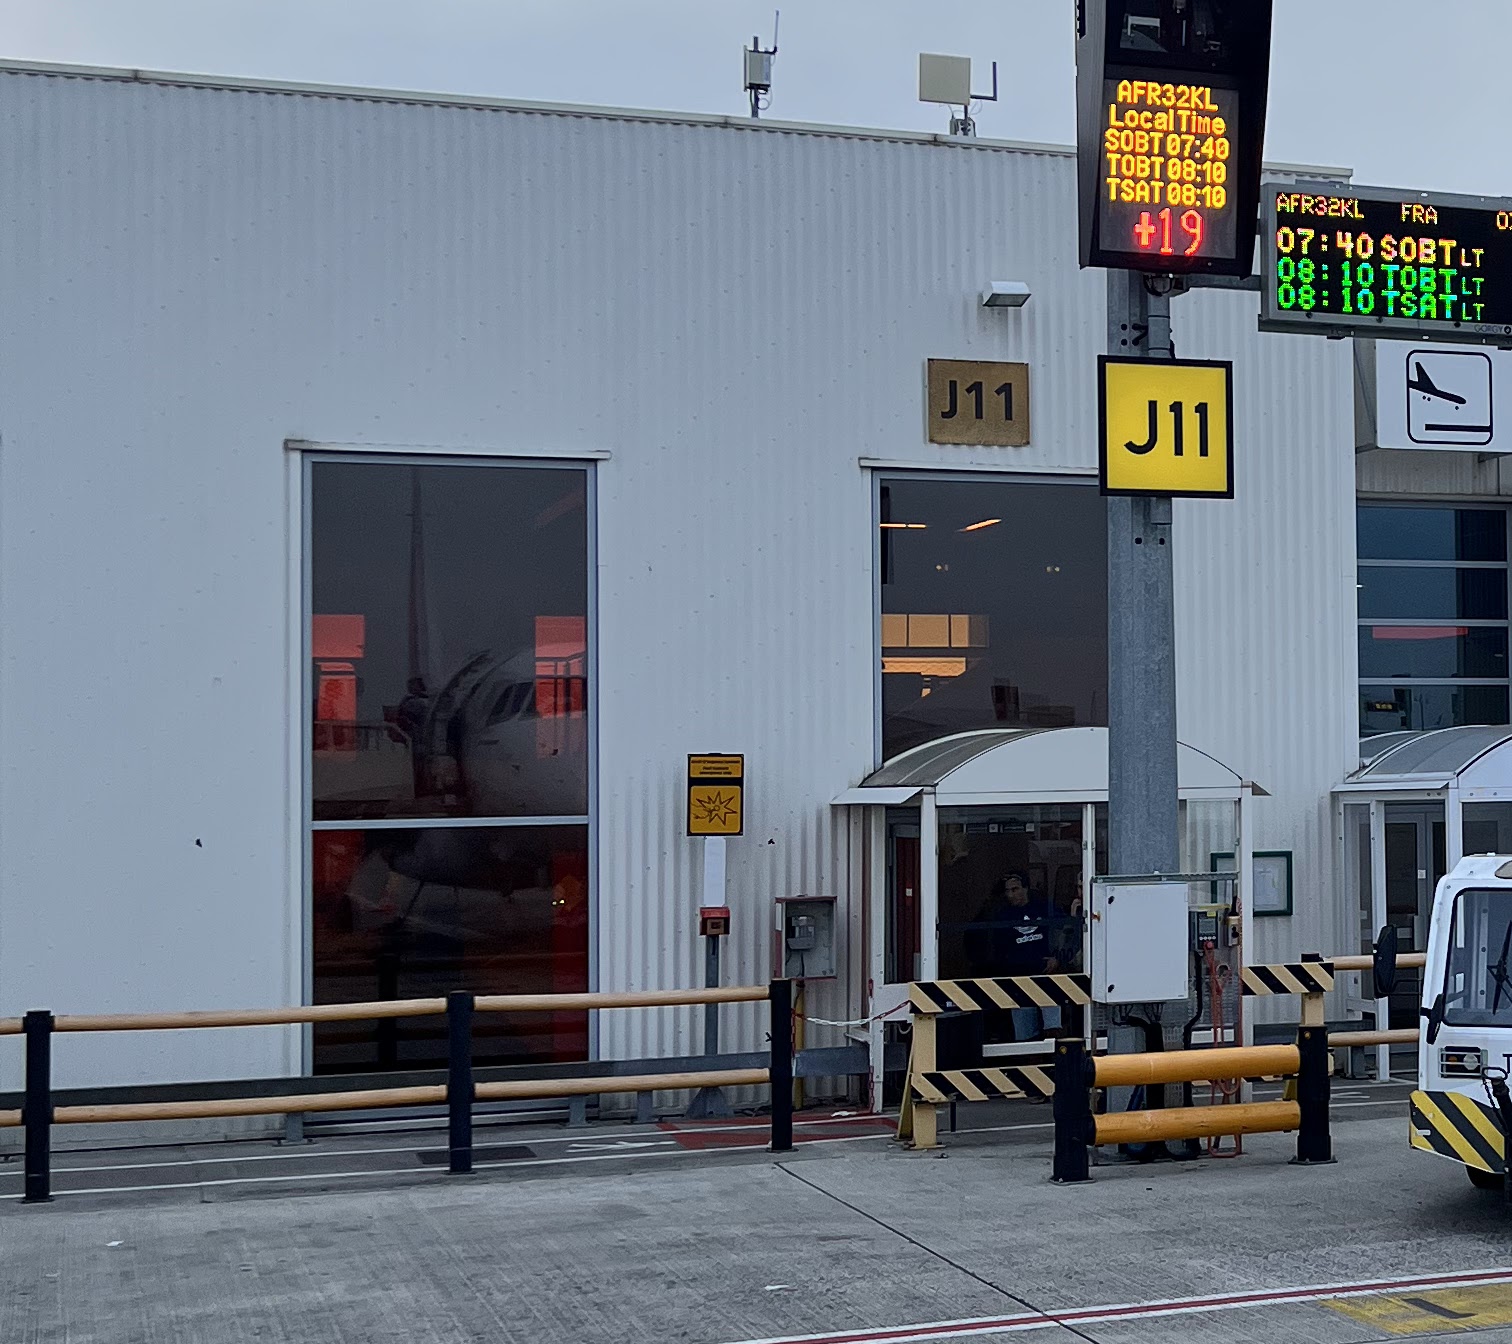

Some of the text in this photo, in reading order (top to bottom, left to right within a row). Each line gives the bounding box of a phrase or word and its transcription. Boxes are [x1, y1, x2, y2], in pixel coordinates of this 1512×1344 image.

[1117, 80, 1219, 111] AFR32KL
[1109, 104, 1226, 135] Local Time
[1104, 128, 1230, 159] SOBT 07:40
[1106, 153, 1227, 184] TOBT 08:10
[1106, 178, 1227, 208] TSAT 08:10
[1276, 193, 1364, 219] AFR32KL
[1401, 203, 1438, 224] FRA
[1134, 207, 1205, 256] +19
[1276, 226, 1485, 268] 07:40 SOBT LT
[1277, 257, 1485, 296] 08:10 TOBT LT
[1277, 283, 1485, 321] 08:10 TSAT LT
[940, 379, 1013, 421] J11
[1124, 400, 1208, 457] J11
